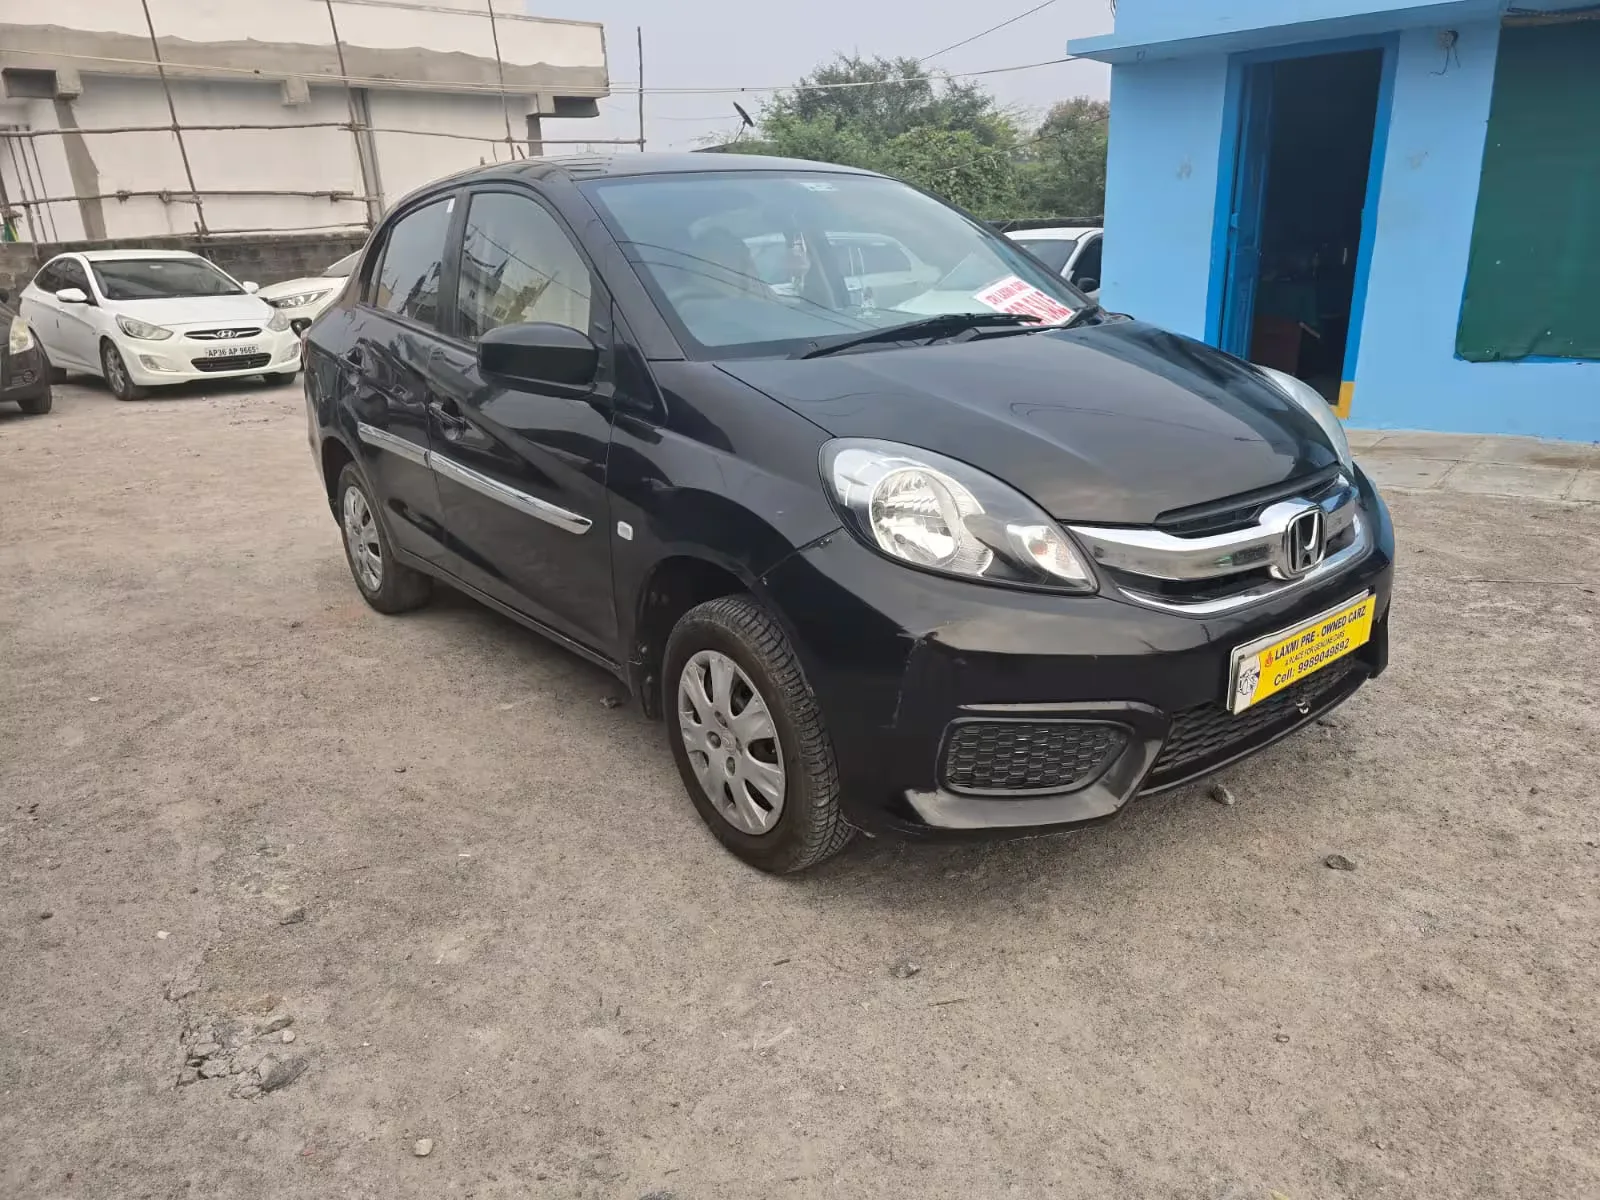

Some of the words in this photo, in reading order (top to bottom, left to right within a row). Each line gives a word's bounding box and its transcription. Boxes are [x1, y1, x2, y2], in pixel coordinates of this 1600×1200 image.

[1275, 640, 1299, 660] LAXMI
[1300, 631, 1315, 647] PRE
[1321, 616, 1346, 636] OWNED
[1348, 606, 1366, 623] CARZ
[1274, 668, 1295, 686] Cell:
[1298, 638, 1349, 673] 9989049892
